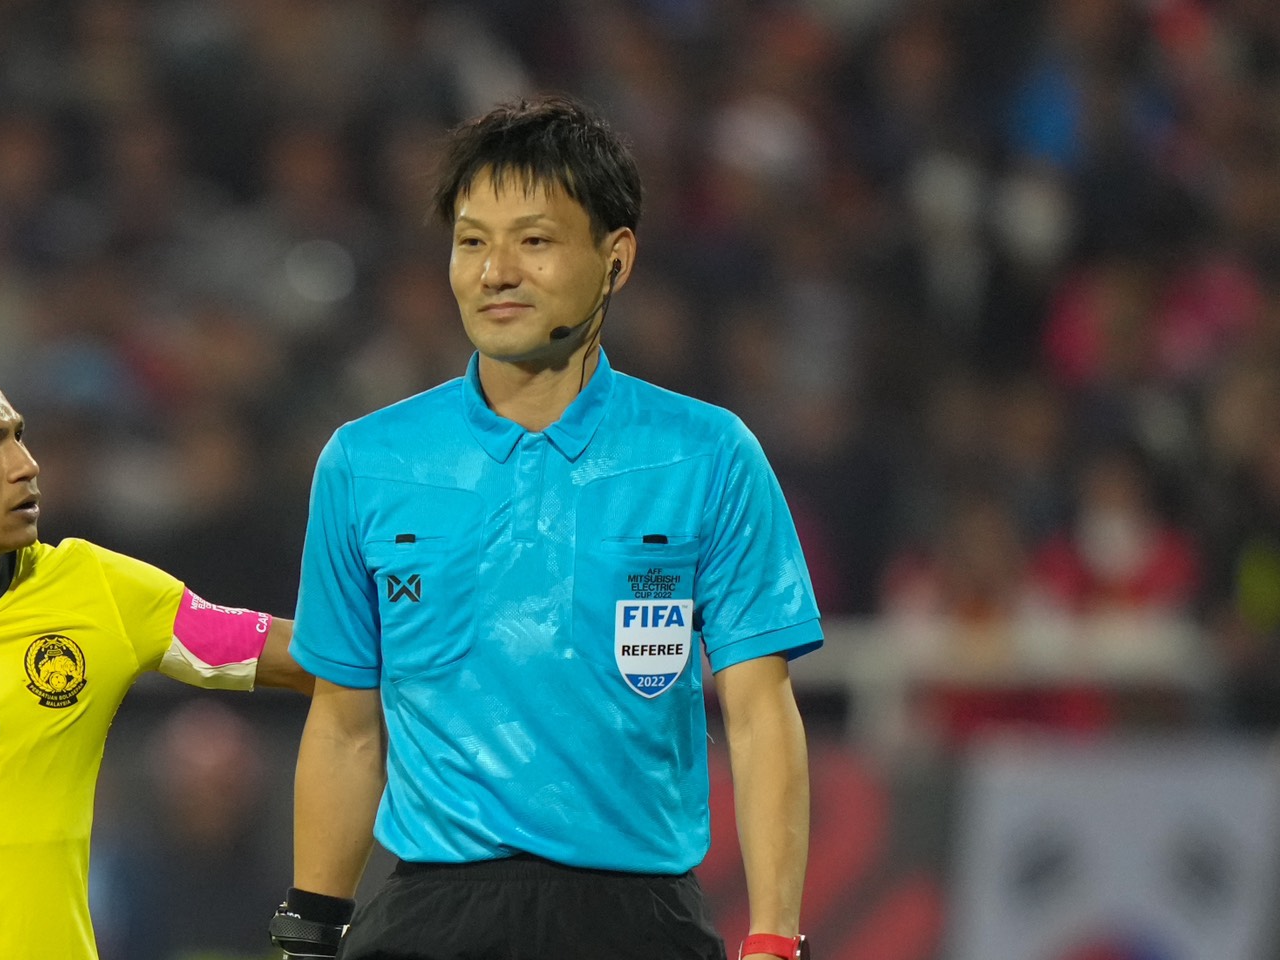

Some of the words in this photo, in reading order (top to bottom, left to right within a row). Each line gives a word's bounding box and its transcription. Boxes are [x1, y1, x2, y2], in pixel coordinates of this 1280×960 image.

[627, 575, 681, 583] MITSUBISHI
[631, 583, 676, 591] ELECTRIC
[634, 591, 652, 599] CUP
[653, 591, 672, 599] 2022
[623, 605, 685, 628] FIFA
[621, 643, 684, 657] REFEREE
[637, 676, 666, 687] 2022
[45, 699, 72, 707] MALAYSIA
